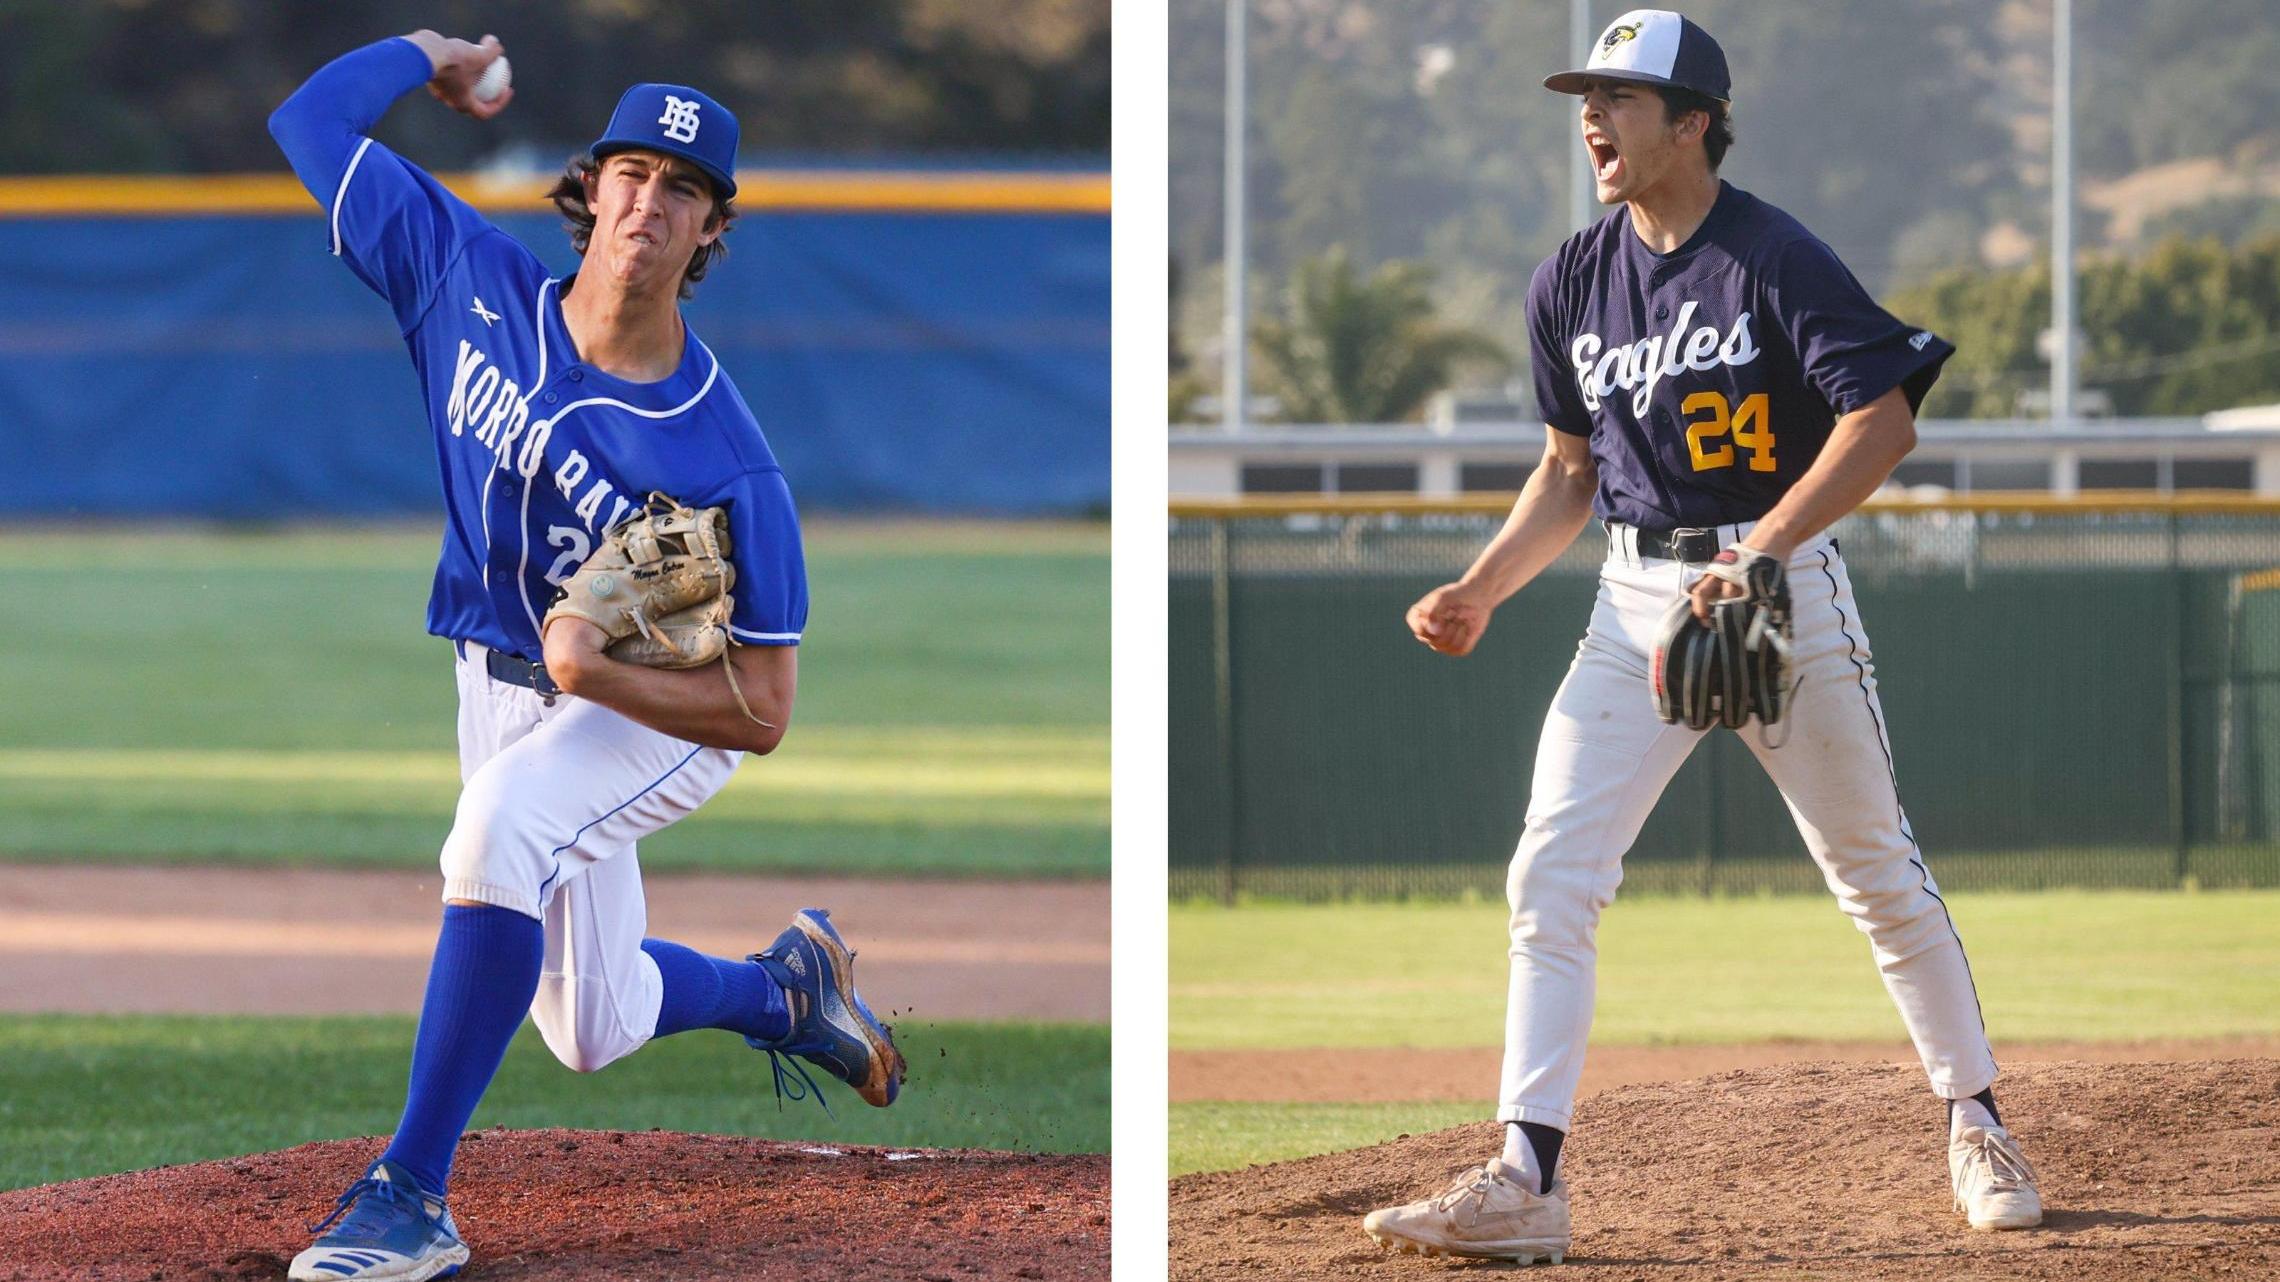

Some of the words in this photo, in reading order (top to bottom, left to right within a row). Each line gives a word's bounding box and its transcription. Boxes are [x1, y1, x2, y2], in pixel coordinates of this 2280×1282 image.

[447, 339, 553, 478] MORRO
[1571, 300, 1761, 419] Eagles
[1681, 390, 1777, 473] 24
